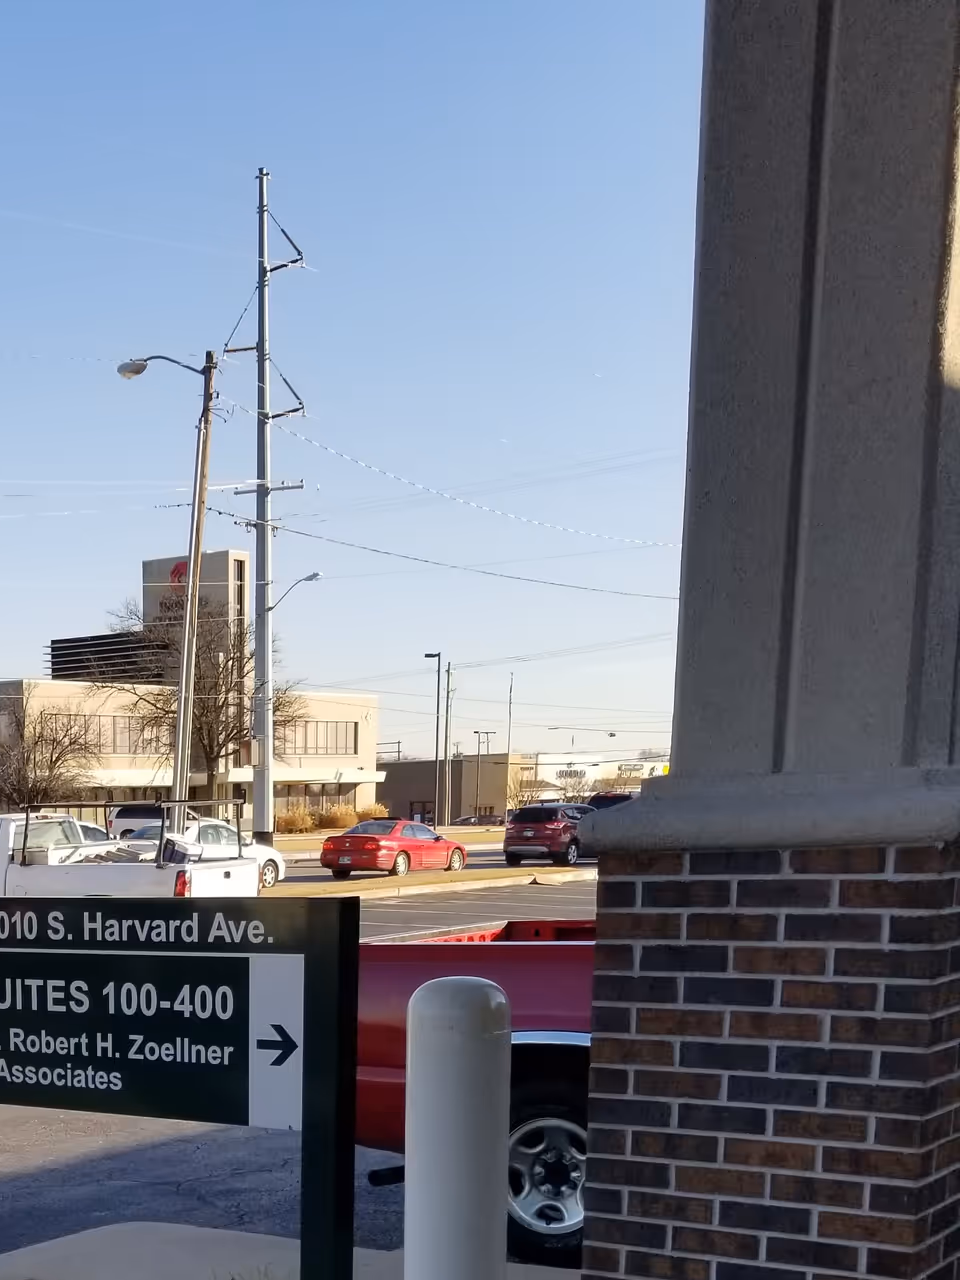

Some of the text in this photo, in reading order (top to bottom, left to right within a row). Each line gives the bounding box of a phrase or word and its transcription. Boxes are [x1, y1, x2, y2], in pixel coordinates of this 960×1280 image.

[47, 910, 73, 941] S.
[83, 911, 199, 943] Harvard
[207, 912, 274, 944] Ave.
[102, 981, 234, 1020] 100-400
[9, 1027, 89, 1057] Robert
[96, 1032, 121, 1058] H.
[127, 1034, 234, 1065] Zoellner
